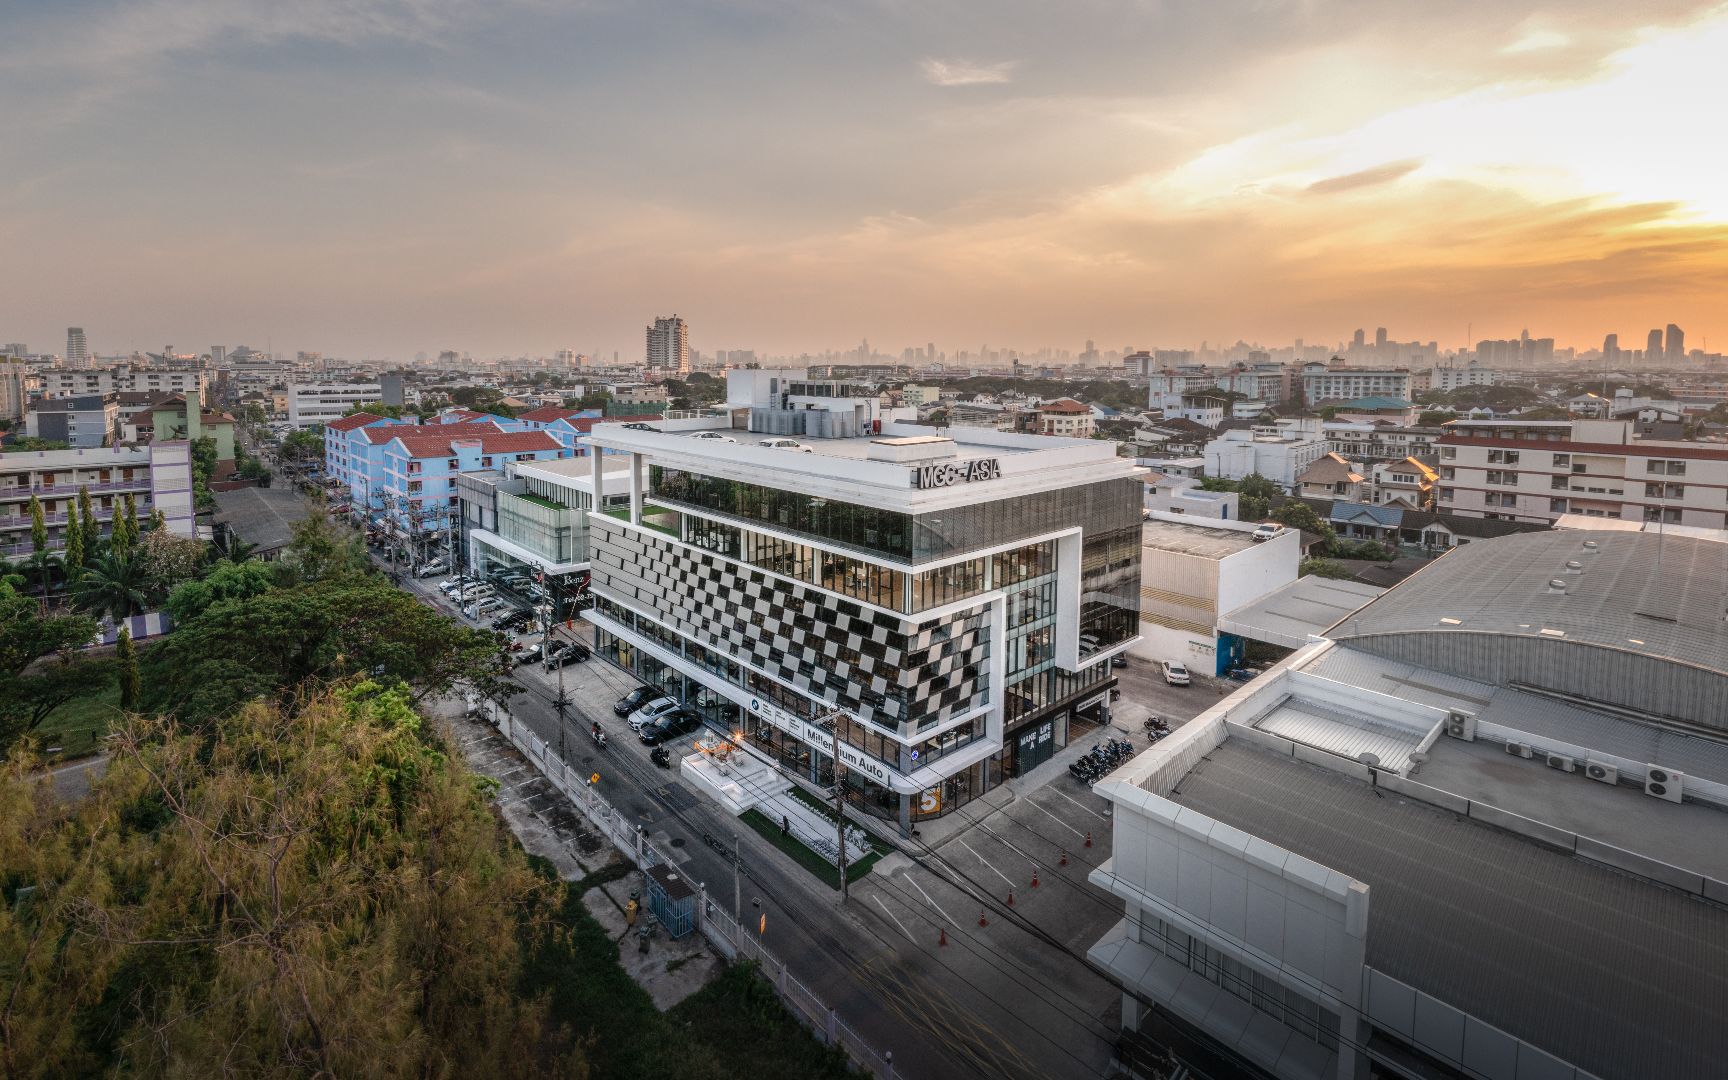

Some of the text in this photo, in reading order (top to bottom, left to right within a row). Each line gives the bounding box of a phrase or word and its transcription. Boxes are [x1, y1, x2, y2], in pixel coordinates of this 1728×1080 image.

[1020, 723, 1051, 746] MAKE LIFE
[1030, 731, 1051, 750] A RIDE
[807, 729, 883, 778] Millenium Auto
